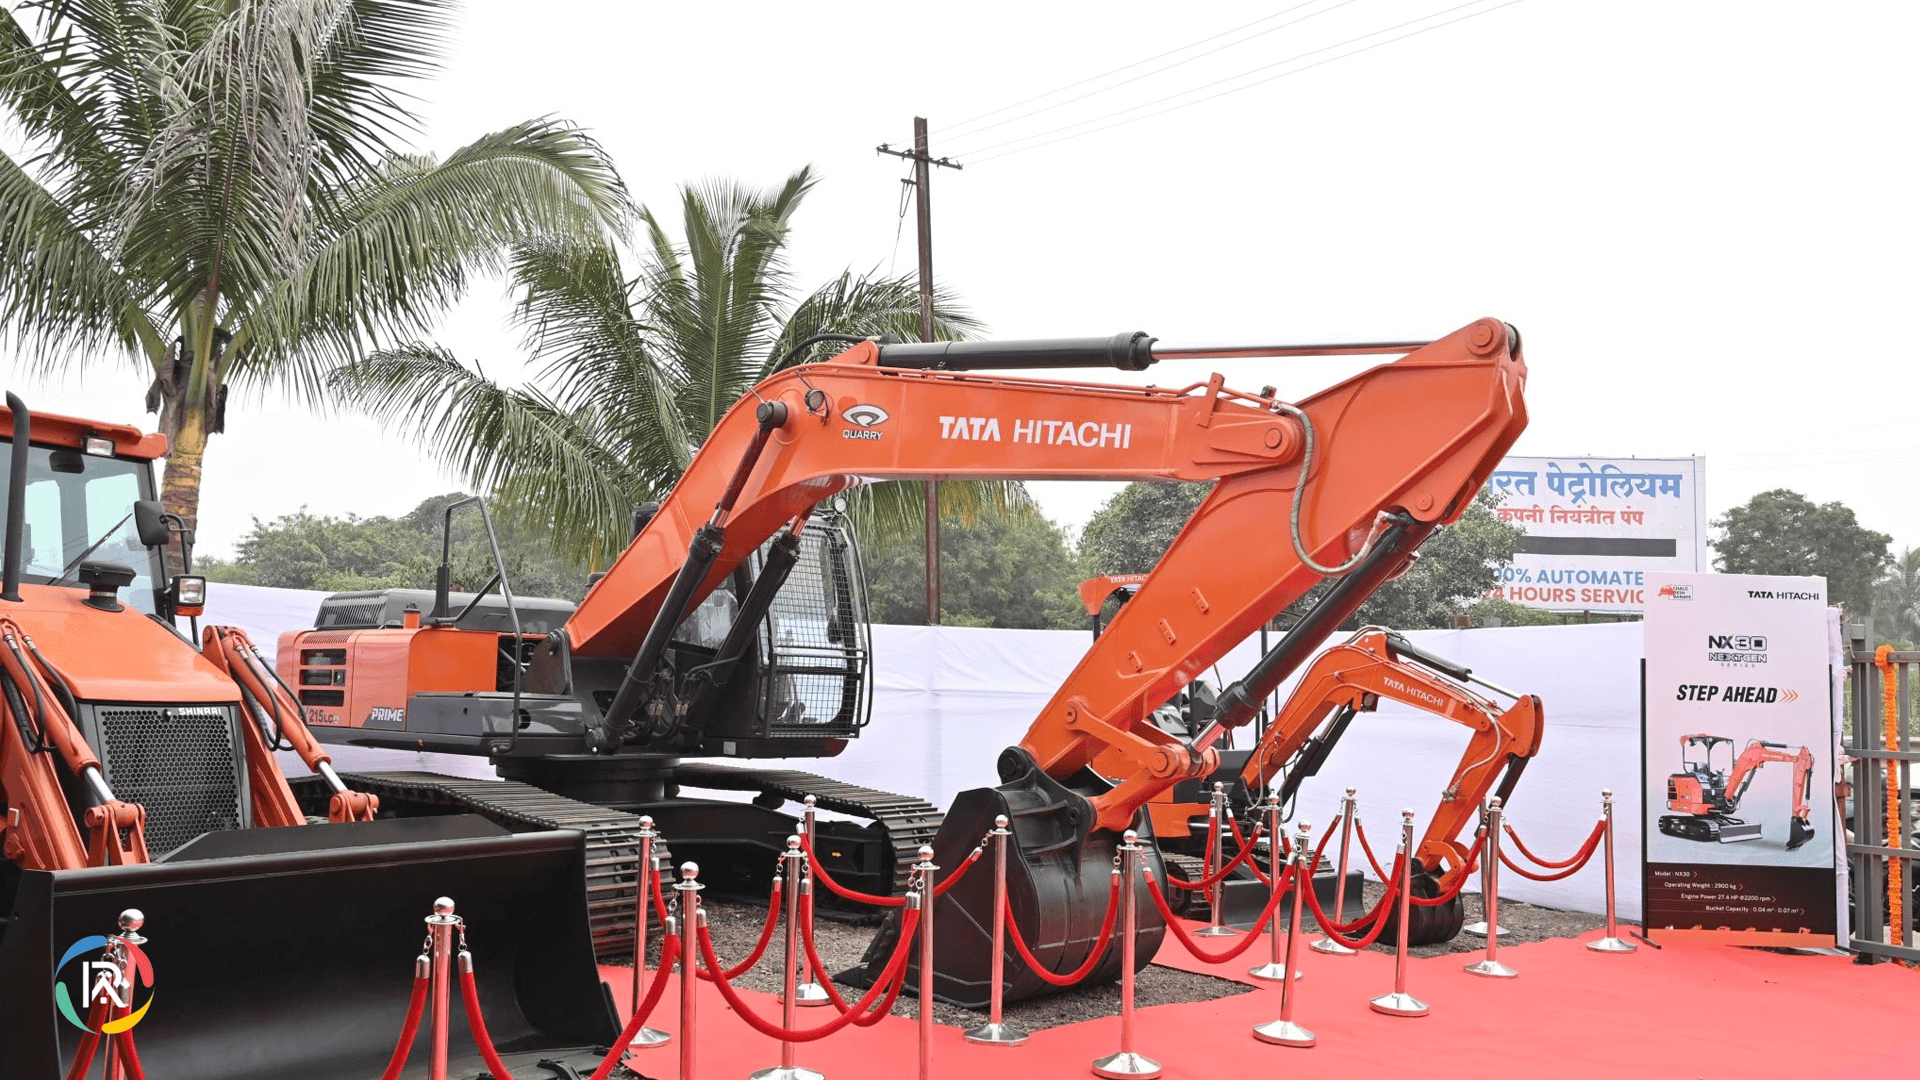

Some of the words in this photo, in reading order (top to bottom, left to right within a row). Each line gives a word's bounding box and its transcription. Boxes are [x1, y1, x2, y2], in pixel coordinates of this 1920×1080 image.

[842, 429, 883, 440] QUARRY
[939, 416, 1001, 442] TATA
[1013, 419, 1131, 449] HITACHI
[1546, 462, 1683, 504] पेट्रोलियम
[1496, 503, 1544, 523] कंपनी
[1549, 504, 1615, 524] नियंत्रीत
[1620, 506, 1644, 525] पंप
[1127, 574, 1149, 582] HITAC
[1510, 586, 1576, 603] HOURS
[1747, 590, 1774, 599] TATA
[1776, 591, 1820, 601] HITACHI
[1708, 635, 1768, 652] NX30
[1383, 676, 1405, 693] TATA
[1406, 686, 1444, 707] HITACHI
[1676, 684, 1719, 702] STEP
[1722, 686, 1778, 704] AHEAD
[178, 707, 222, 715] SHINRAI
[371, 707, 404, 722] PRIME
